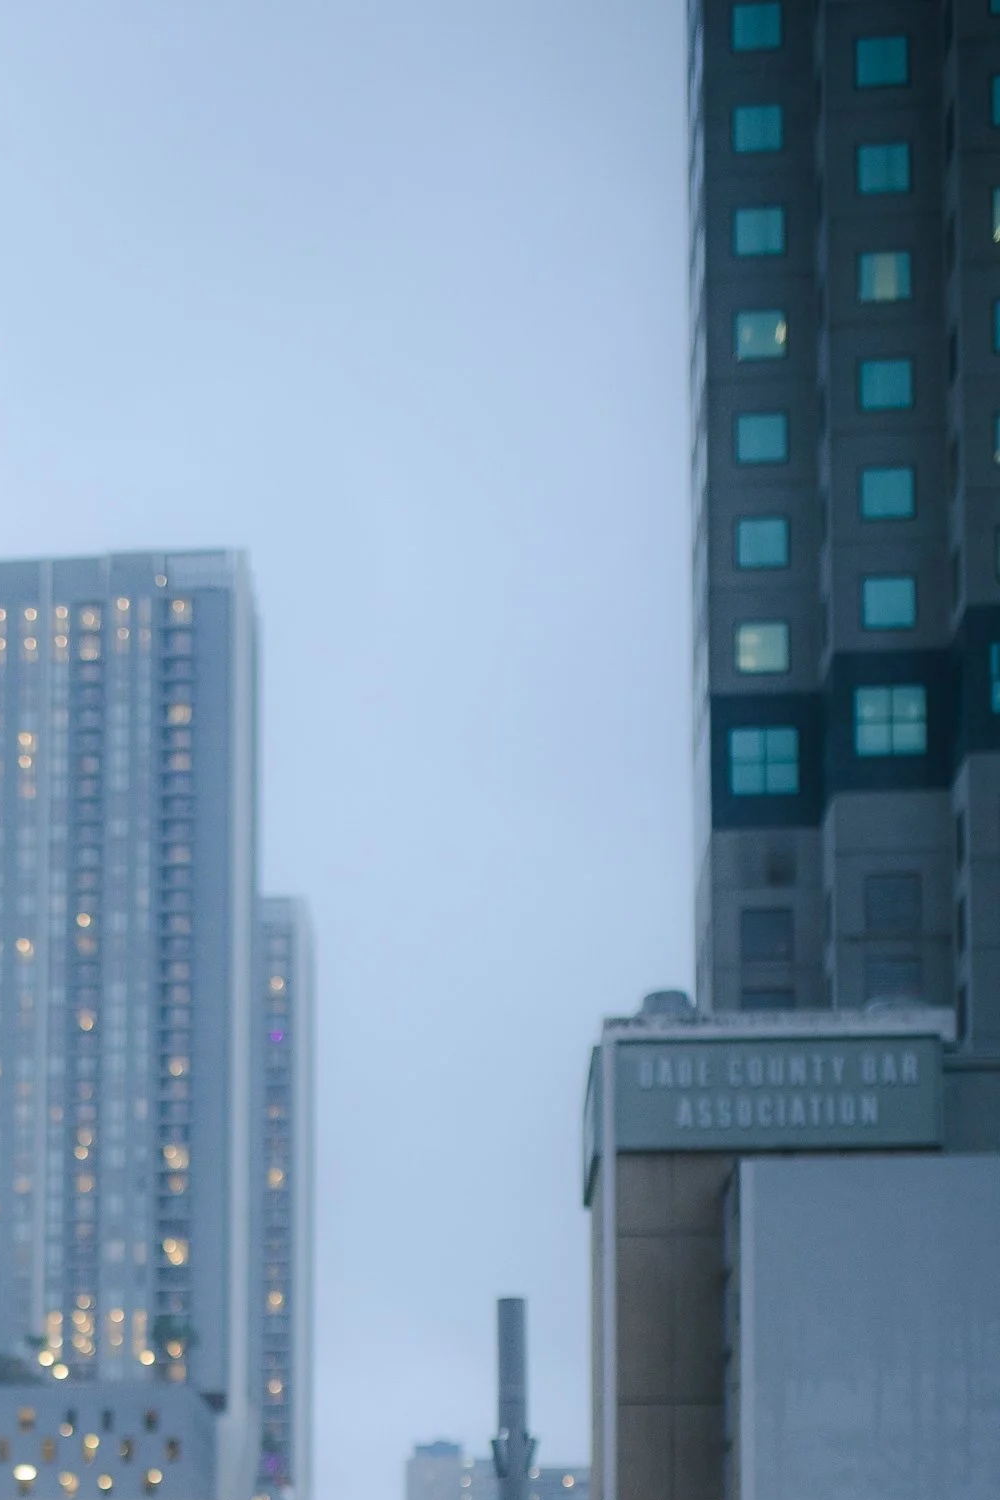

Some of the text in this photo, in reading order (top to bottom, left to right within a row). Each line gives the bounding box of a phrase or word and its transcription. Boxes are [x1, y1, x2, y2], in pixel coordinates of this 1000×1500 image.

[639, 1052, 919, 1089] DADE COUNTY BAR
[677, 1094, 879, 1128] ASSOCIATION
